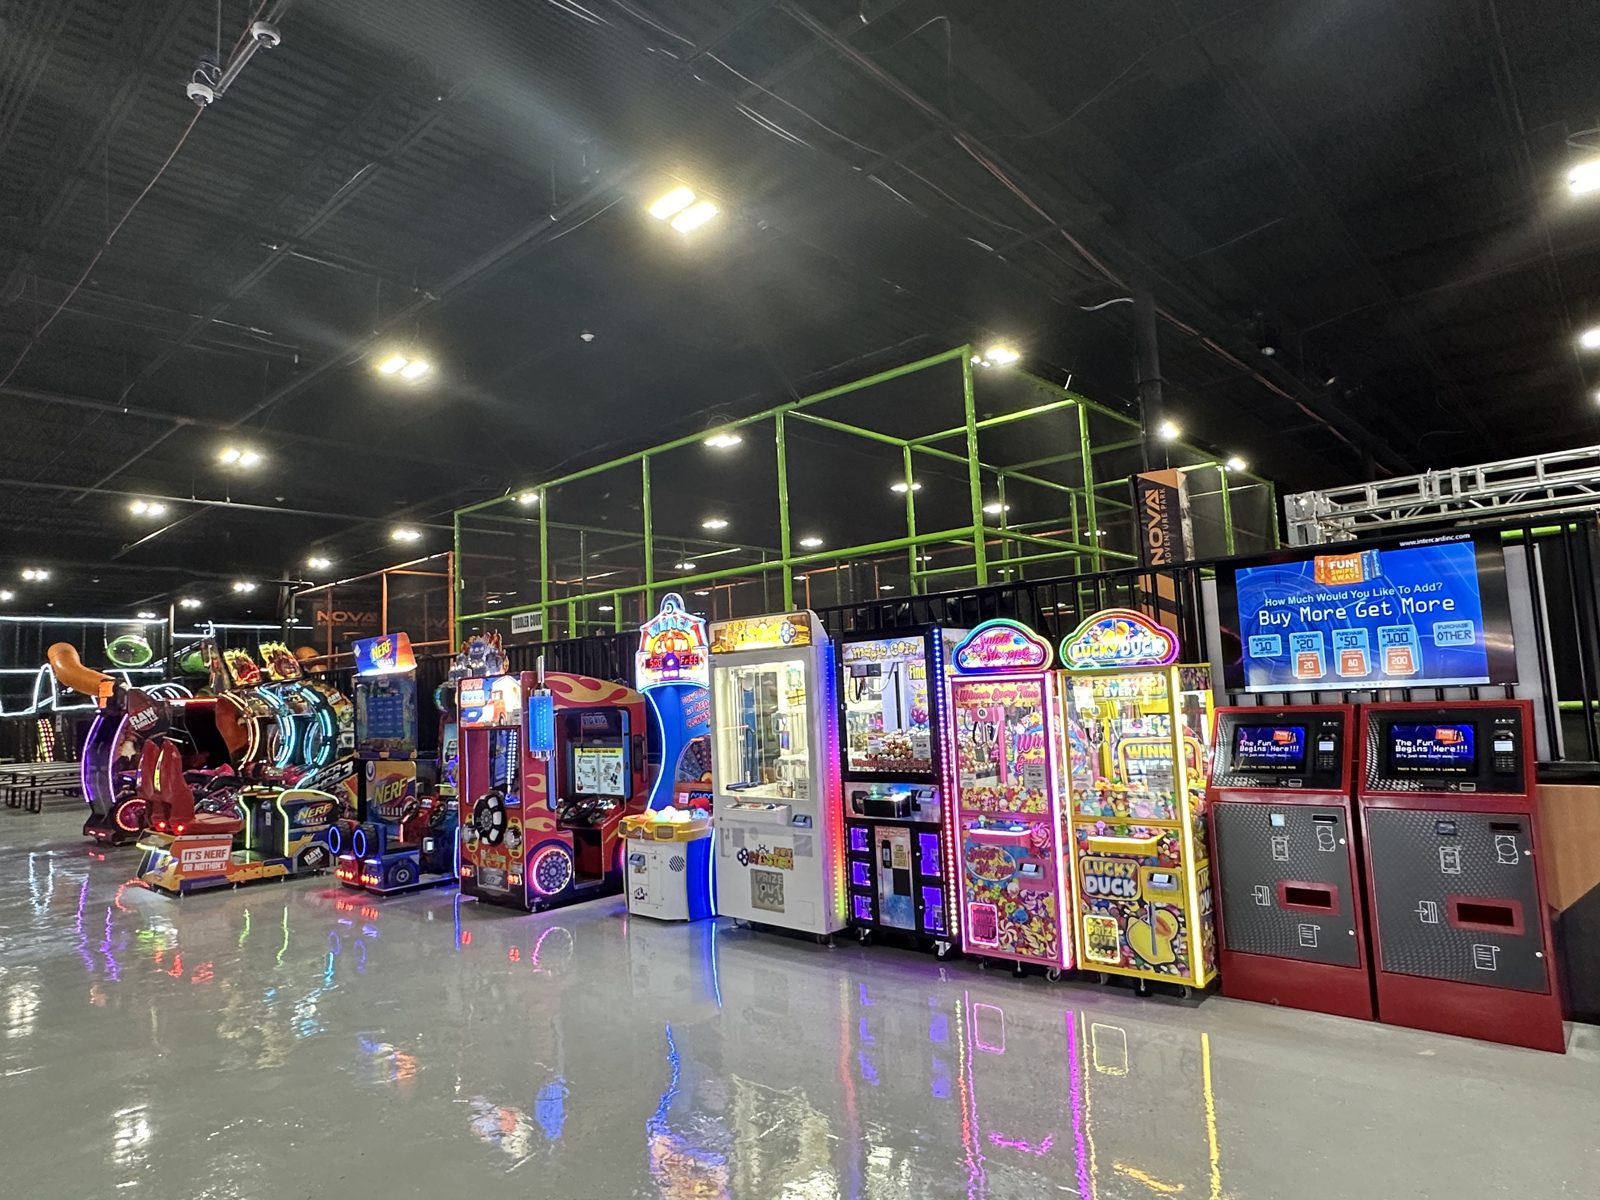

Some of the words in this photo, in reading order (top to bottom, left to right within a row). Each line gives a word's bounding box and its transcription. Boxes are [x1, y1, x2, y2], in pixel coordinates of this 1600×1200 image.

[1158, 488, 1166, 510] PARK
[1145, 489, 1165, 566] NOVA
[1161, 510, 1172, 563] ADVENTURE
[1400, 532, 1471, 547] www.intercardinc.com
[1265, 597, 1286, 607] How
[1288, 595, 1314, 604] Much
[1316, 592, 1348, 602] Would
[1350, 590, 1370, 599] You
[1373, 587, 1395, 598] Like
[1398, 586, 1411, 595] To
[1413, 582, 1443, 593] Add?
[317, 610, 377, 622] NOVA
[1259, 610, 1291, 627] Buy
[1300, 606, 1347, 622] More
[1355, 602, 1392, 618] Get
[1402, 597, 1455, 614] More
[1437, 630, 1472, 641] OTHER
[372, 639, 392, 660] NERF
[1119, 638, 1165, 656] DUCK
[129, 706, 156, 726] RAW
[1396, 746, 1428, 754] Begins
[374, 778, 407, 806] NERF
[298, 803, 332, 821] NERF
[184, 850, 202, 861] IT'S
[204, 848, 227, 860] NERF
[304, 847, 324, 866] RAW
[1084, 860, 1136, 877] LUCKY
[757, 872, 784, 884] PRIZE
[1086, 876, 1136, 897] DUCK
[1088, 926, 1118, 937] PRIZE
[1091, 936, 1116, 946] OUT
